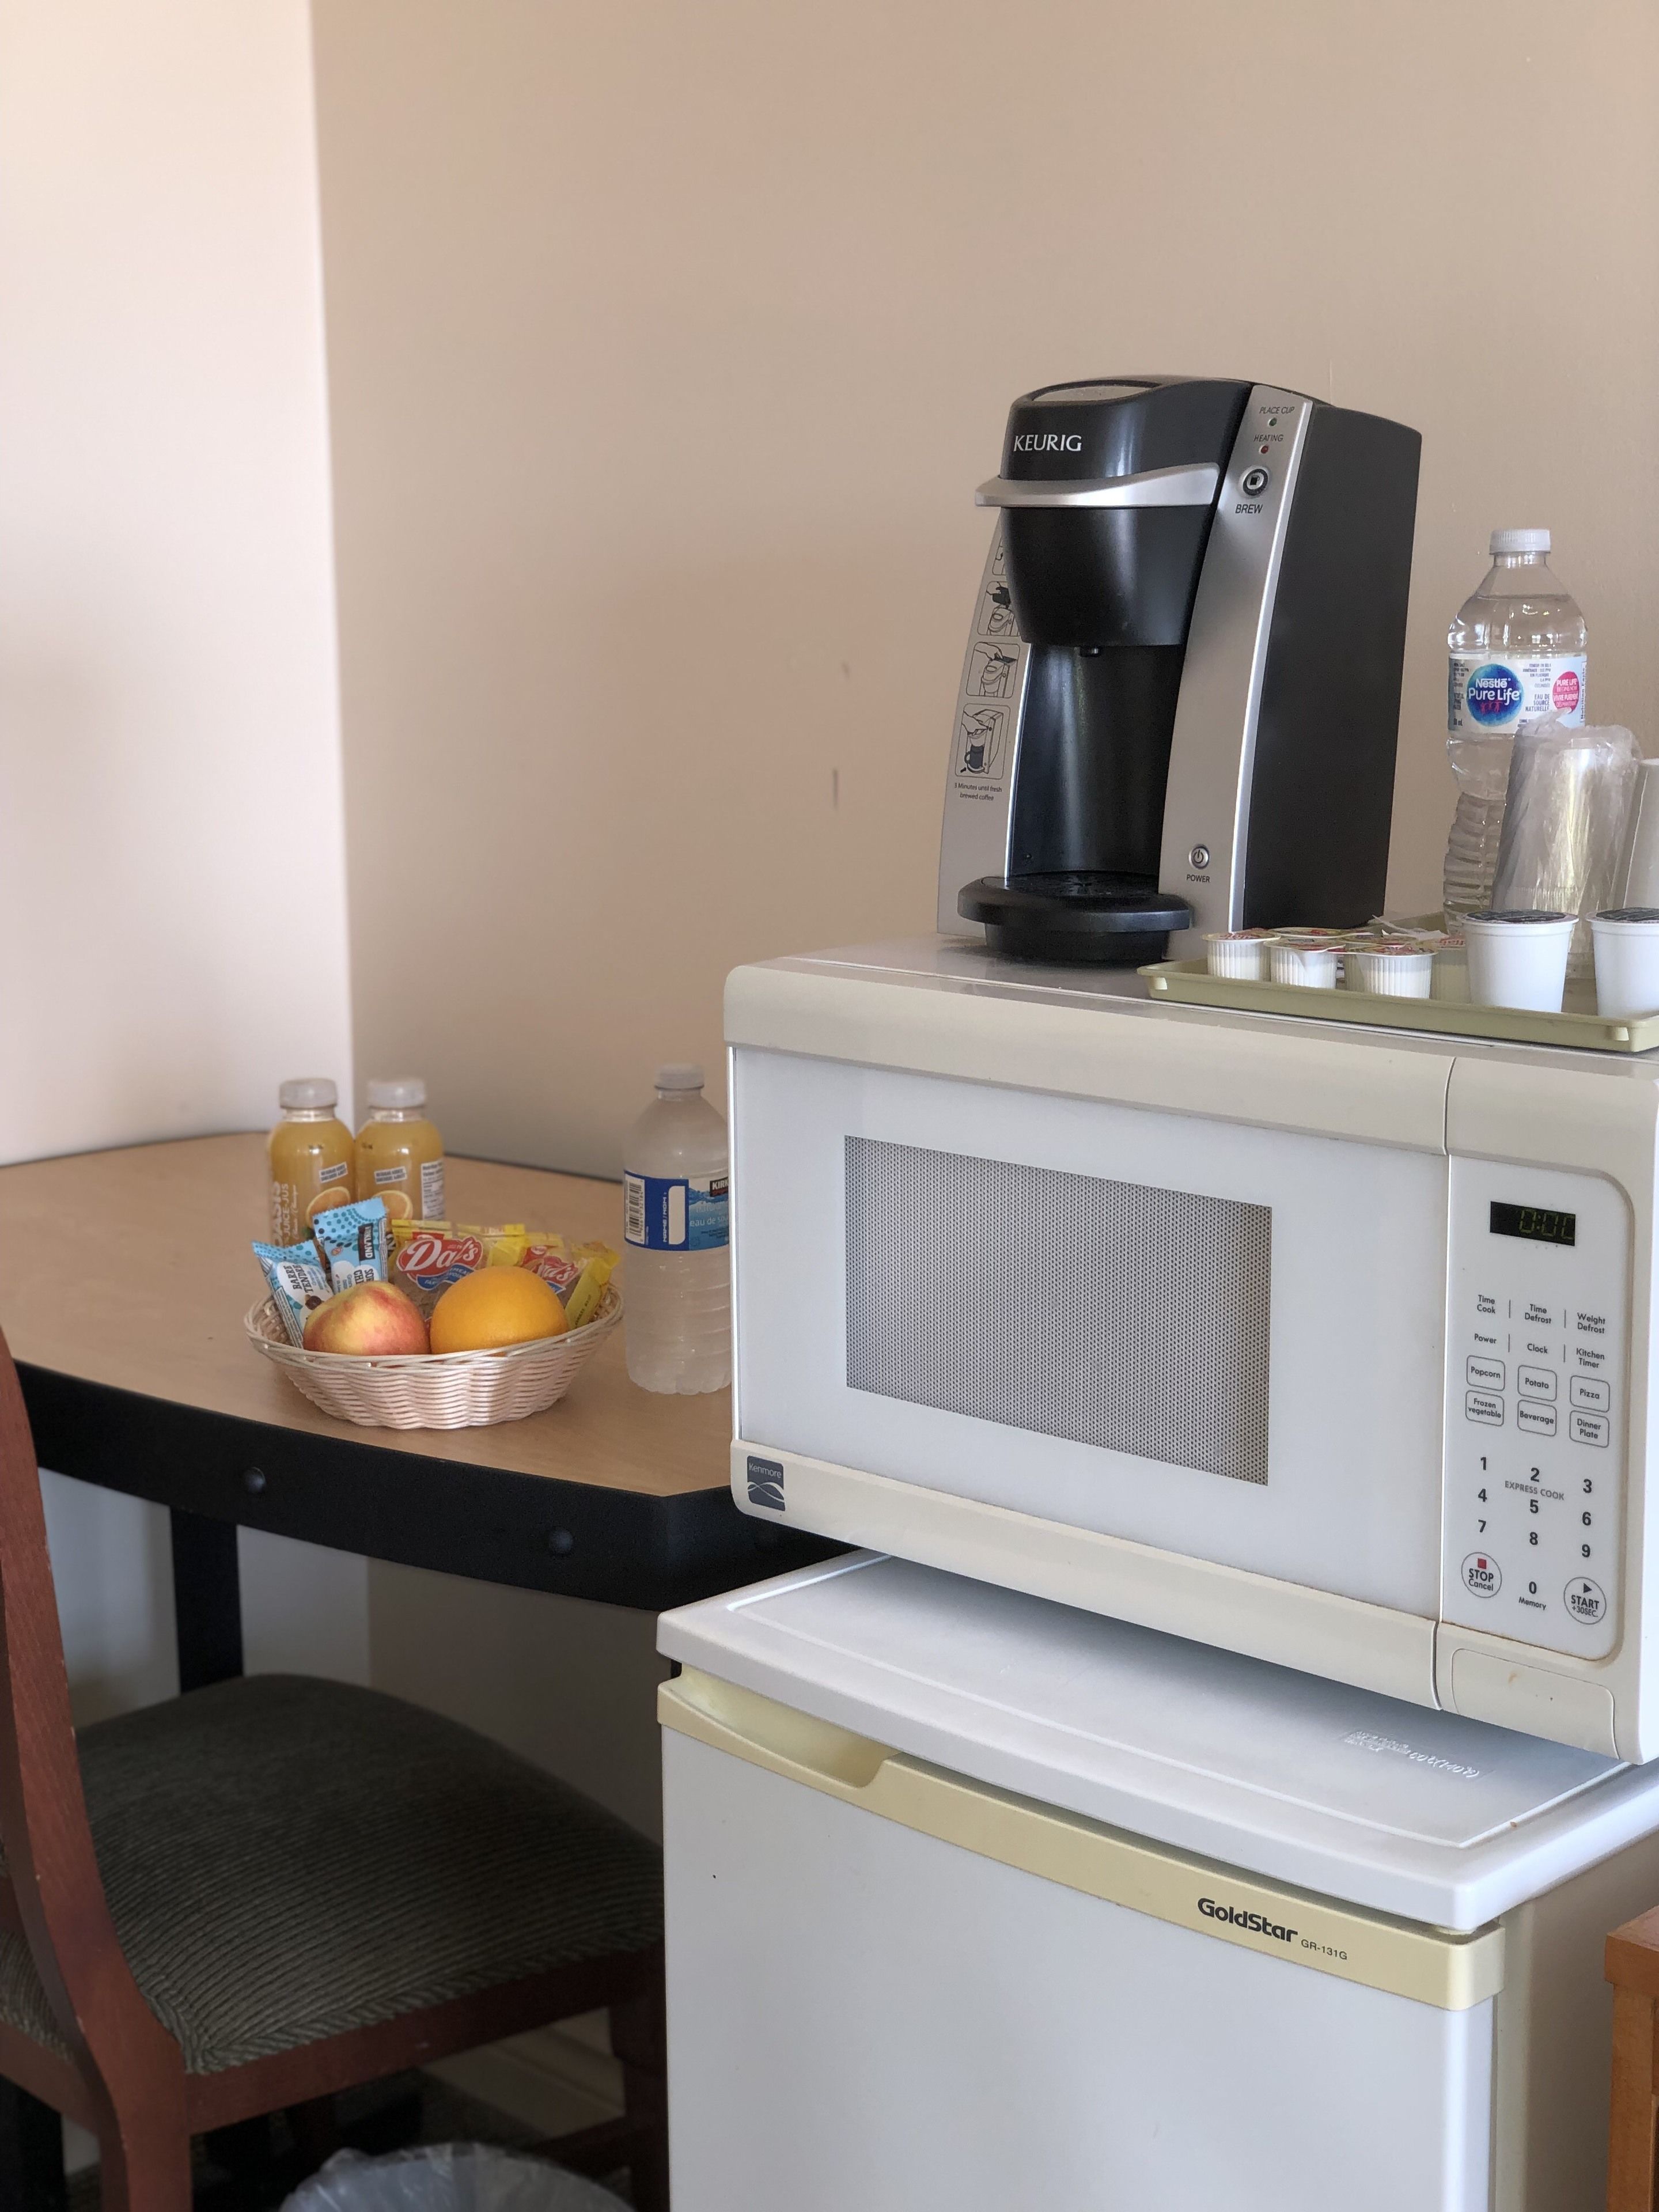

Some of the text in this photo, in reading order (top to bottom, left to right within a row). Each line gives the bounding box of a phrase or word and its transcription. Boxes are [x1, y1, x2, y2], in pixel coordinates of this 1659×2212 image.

[1259, 406, 1280, 414] PLACE
[1013, 434, 1083, 453] KEURIG
[1253, 434, 1284, 442] HEATING
[1234, 503, 1263, 514] BREW
[1468, 687, 1496, 701] Pure
[1498, 687, 1521, 706] Life
[1186, 874, 1210, 883] POWER
[281, 1183, 290, 1236] JUICE-JUS
[707, 1216, 716, 1225] de
[1478, 1294, 1495, 1305] Time
[1476, 1304, 1496, 1315] Cook
[1529, 1304, 1547, 1315] Time
[1524, 1312, 1552, 1324] Defrost
[1577, 1312, 1606, 1325] Weight
[1577, 1322, 1605, 1334] Defrost
[1474, 1334, 1497, 1344] Power
[1527, 1343, 1548, 1354] Clock
[1576, 1347, 1605, 1361] Kitchen
[1578, 1357, 1600, 1369] Timer
[1471, 1366, 1501, 1380] Popcorn
[1525, 1377, 1550, 1389] Potato
[1580, 1388, 1601, 1400] Pizza
[1473, 1397, 1497, 1410] Frozen
[1468, 1406, 1502, 1419] vegetable
[1520, 1411, 1554, 1425] Beverage
[1577, 1418, 1602, 1431] Dinner
[1580, 1430, 1599, 1440] Plate
[748, 1462, 782, 1479] Kenmore
[1480, 1456, 1487, 1471] 1
[1530, 1467, 1540, 1483] 2
[1504, 1480, 1565, 1501] EXPRESS COOK
[1582, 1479, 1593, 1494] 3
[1478, 1488, 1487, 1502] 4
[1529, 1499, 1539, 1514] 5
[1478, 1519, 1487, 1533] 7
[1582, 1511, 1592, 1527] 6
[1529, 1532, 1539, 1546] 8
[1581, 1544, 1591, 1558] 9
[1468, 1567, 1494, 1583] STOP
[1468, 1578, 1494, 1592] Cancel
[1528, 1581, 1537, 1595] 0
[1518, 1596, 1547, 1611] Memory
[1571, 1594, 1600, 1609] START
[1572, 1605, 1598, 1618] +30SEC.
[1197, 1896, 1348, 1961] GoldStar GR-131G
